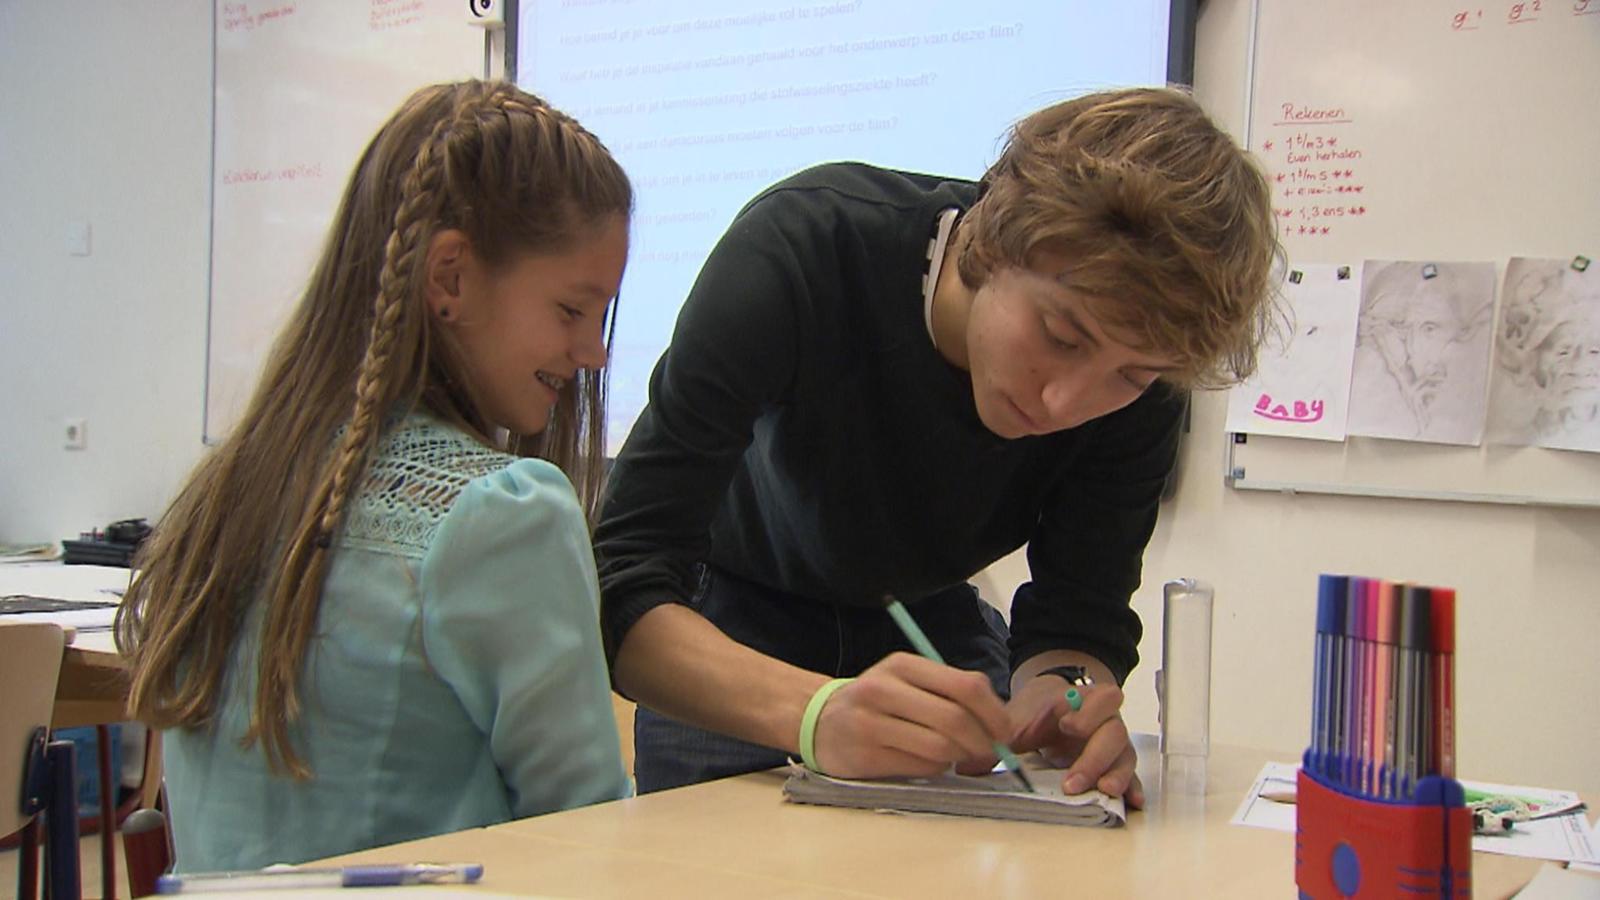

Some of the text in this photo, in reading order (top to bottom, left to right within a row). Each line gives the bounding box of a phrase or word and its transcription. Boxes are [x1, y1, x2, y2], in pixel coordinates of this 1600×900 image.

[694, 17, 721, 30] deze
[779, 7, 795, 20] rol
[814, 0, 862, 19] spelen?
[747, 48, 795, 66] gehaald
[799, 45, 825, 57] voor
[828, 41, 849, 54] het
[851, 34, 921, 51] onderwerp
[924, 32, 948, 45] van
[951, 29, 986, 43] deze
[990, 21, 1024, 39] film?
[895, 71, 938, 89] heeft?
[1281, 103, 1345, 121] Rekenen
[774, 123, 815, 140] volgen
[817, 122, 846, 136] voor
[1287, 149, 1362, 164] Even herhalen
[1255, 393, 1324, 422] BABY
